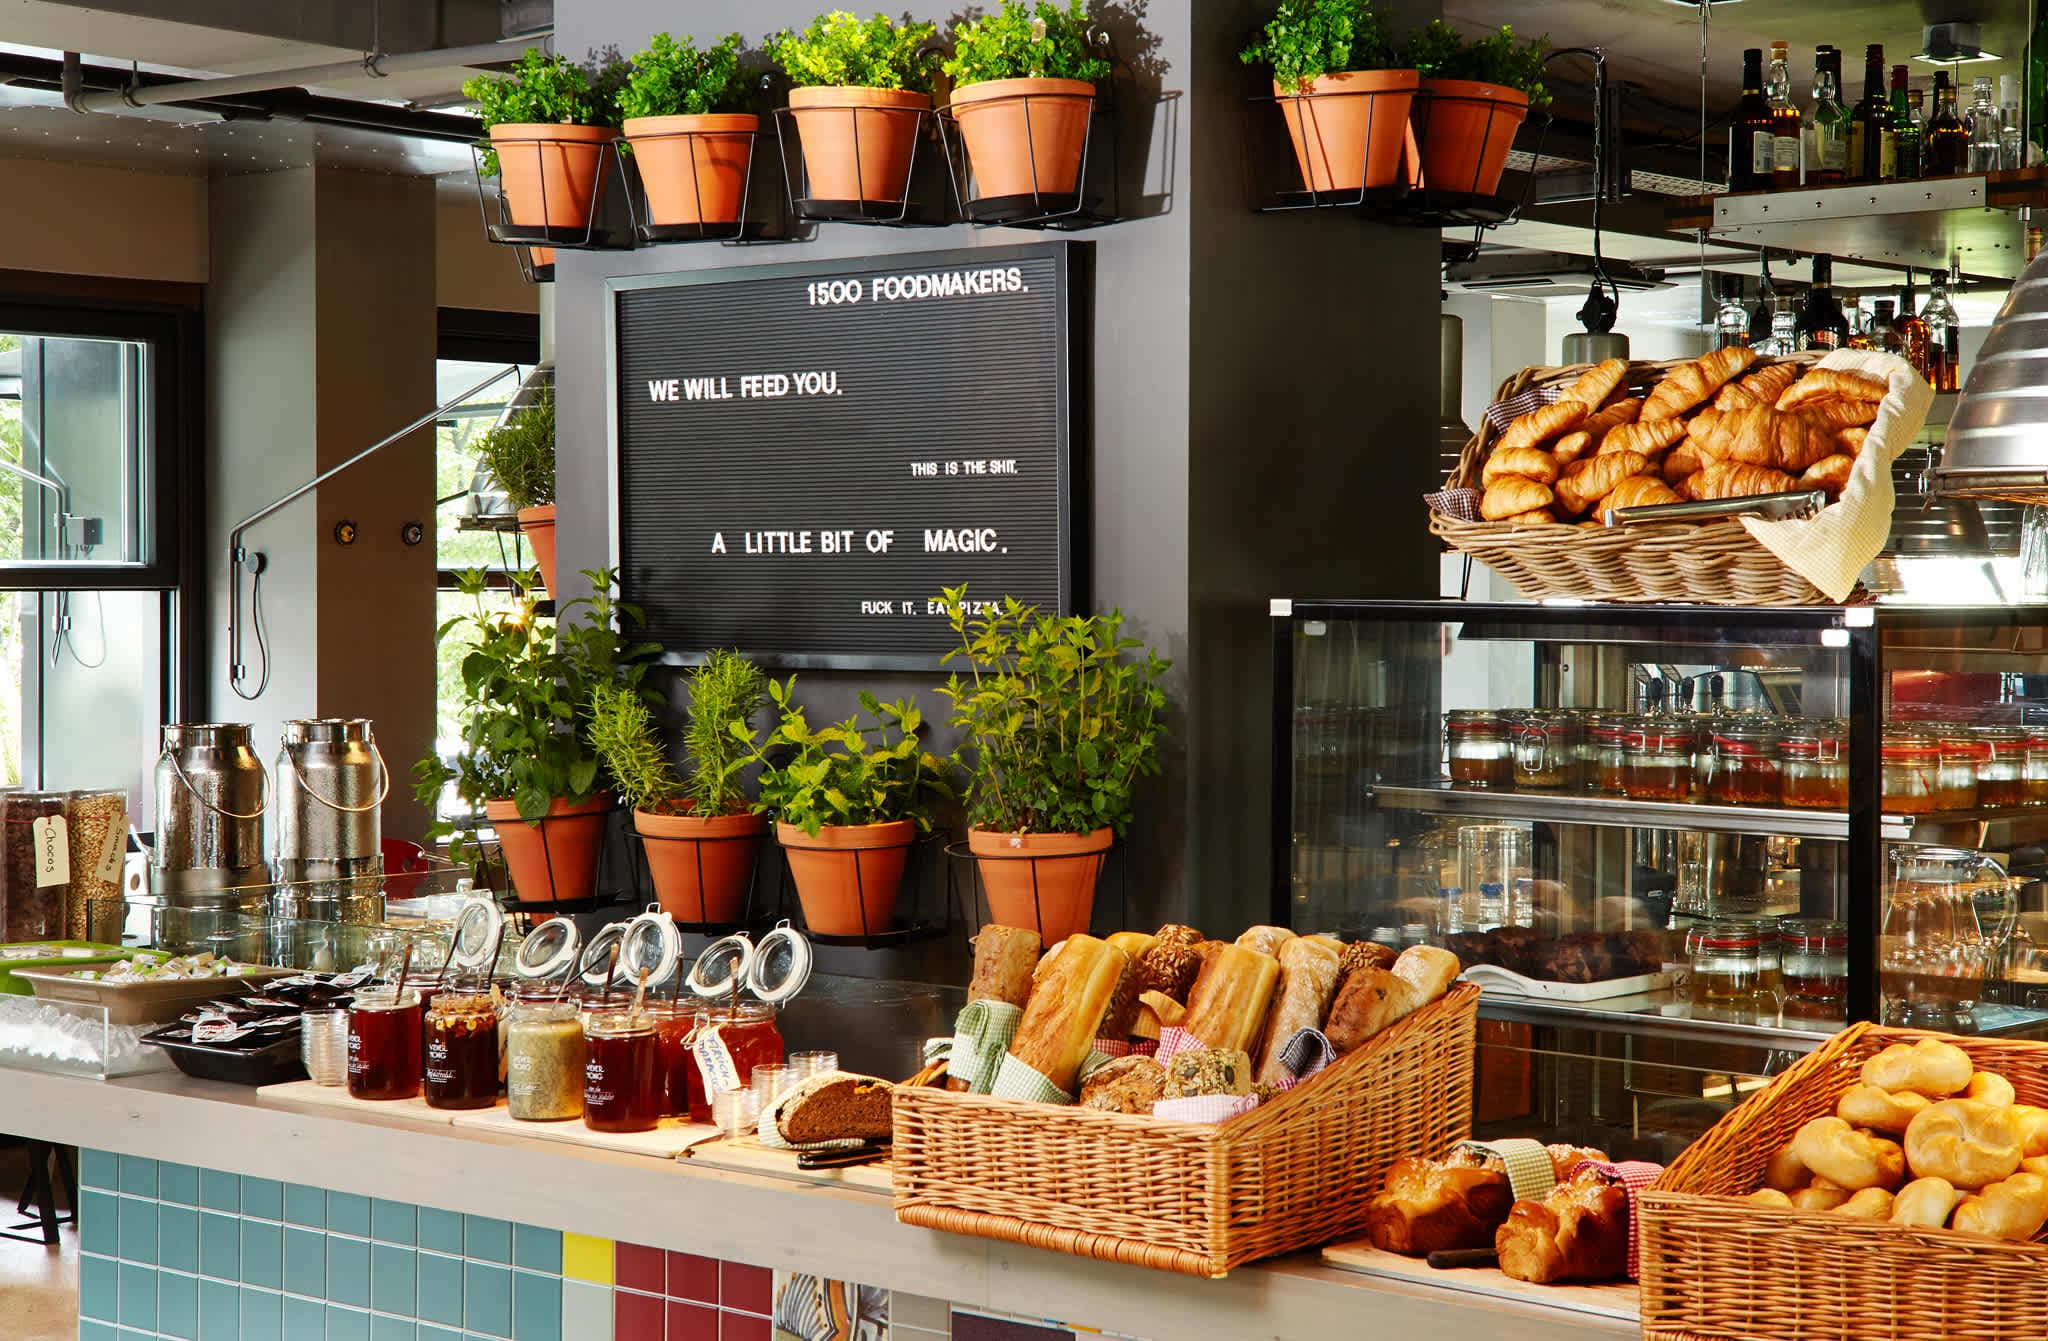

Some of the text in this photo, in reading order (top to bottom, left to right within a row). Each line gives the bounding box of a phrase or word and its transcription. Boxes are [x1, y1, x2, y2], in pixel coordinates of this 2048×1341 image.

[807, 266, 1030, 306] 1500 FOODMAKERS.
[648, 371, 843, 402] WE WILL FEED YOU.
[910, 459, 1018, 477] THIS IS THE SHIT.
[711, 528, 1008, 554] A LITTLE BIT OF MAGIC.
[861, 601, 893, 615] FUCK
[902, 601, 917, 615] IT.
[44, 827, 57, 873] Chocos
